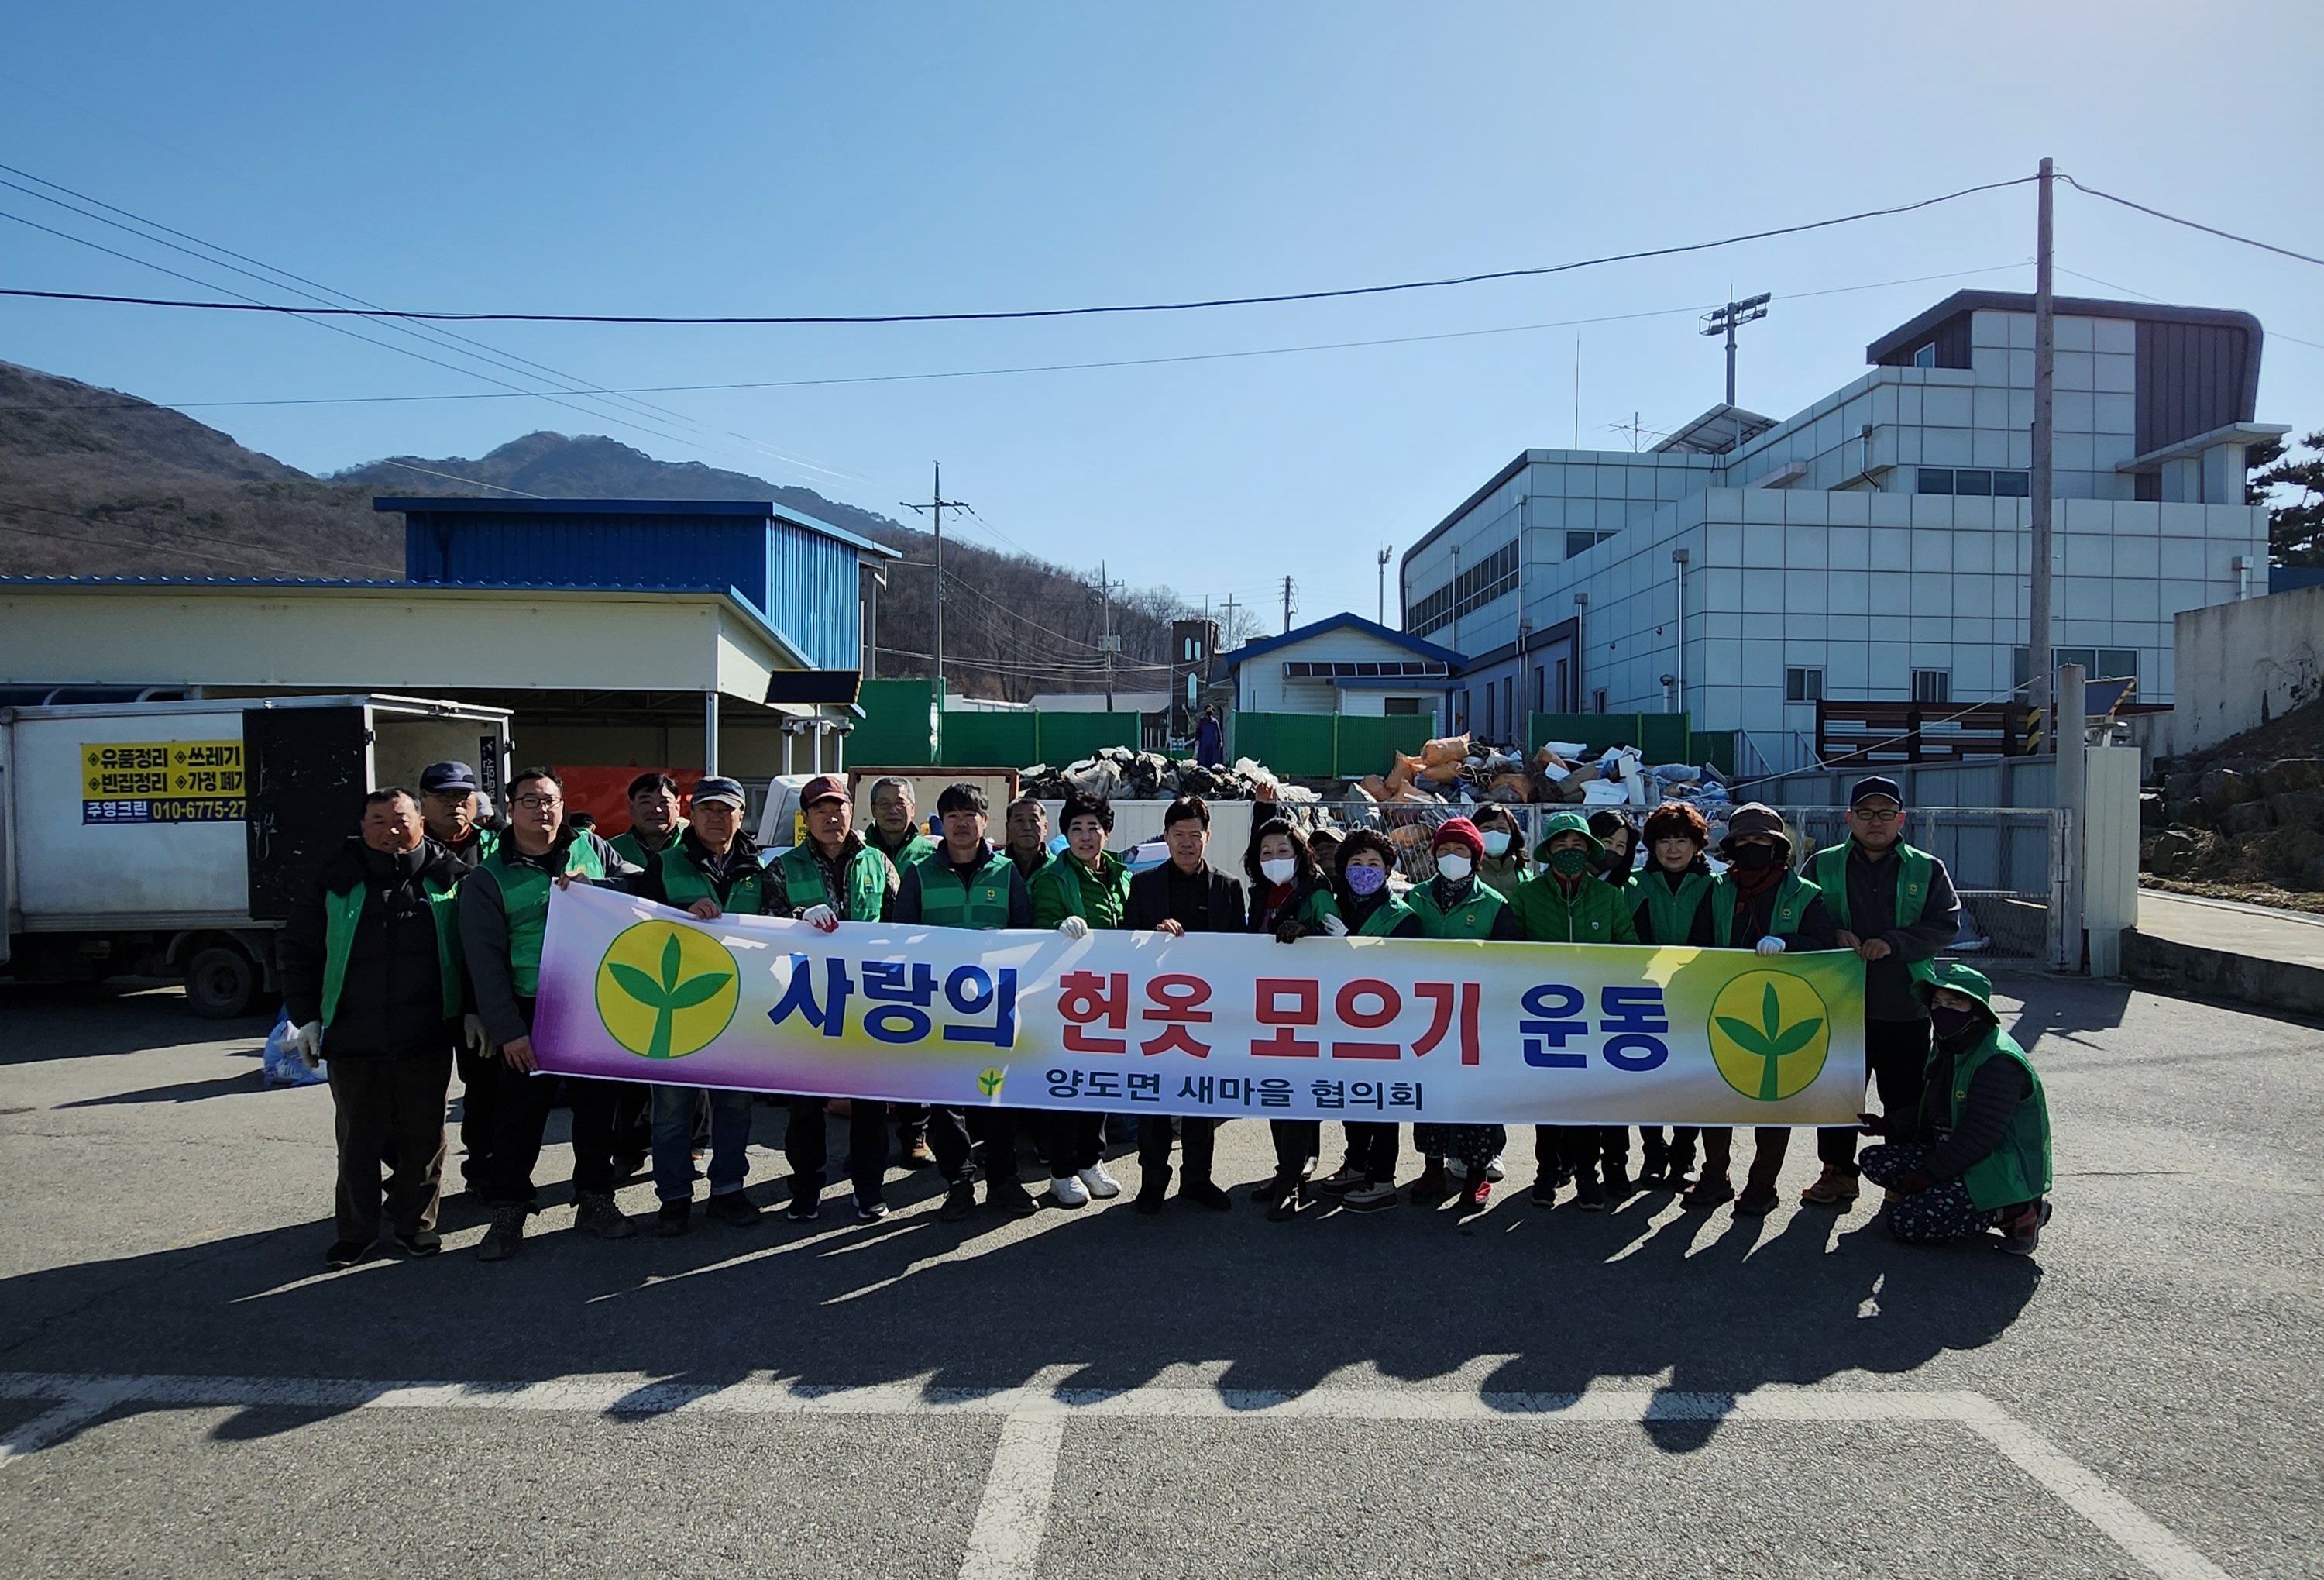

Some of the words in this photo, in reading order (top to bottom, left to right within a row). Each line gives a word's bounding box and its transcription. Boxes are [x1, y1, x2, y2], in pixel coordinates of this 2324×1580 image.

[101, 748, 168, 769] 유품정리
[188, 746, 240, 766] 쓰레기
[101, 773, 167, 793] 빈집정리
[189, 773, 216, 792] 가정
[87, 801, 147, 817] 주영크린
[768, 953, 1018, 1048] 사랑의
[1058, 970, 1212, 1060] 헌옷
[1250, 977, 1481, 1066] 모으기
[1519, 983, 1669, 1072] 운동
[1045, 1069, 1161, 1103] 양도면
[1177, 1075, 1294, 1108] 새마을
[1310, 1078, 1423, 1111] 협의회
